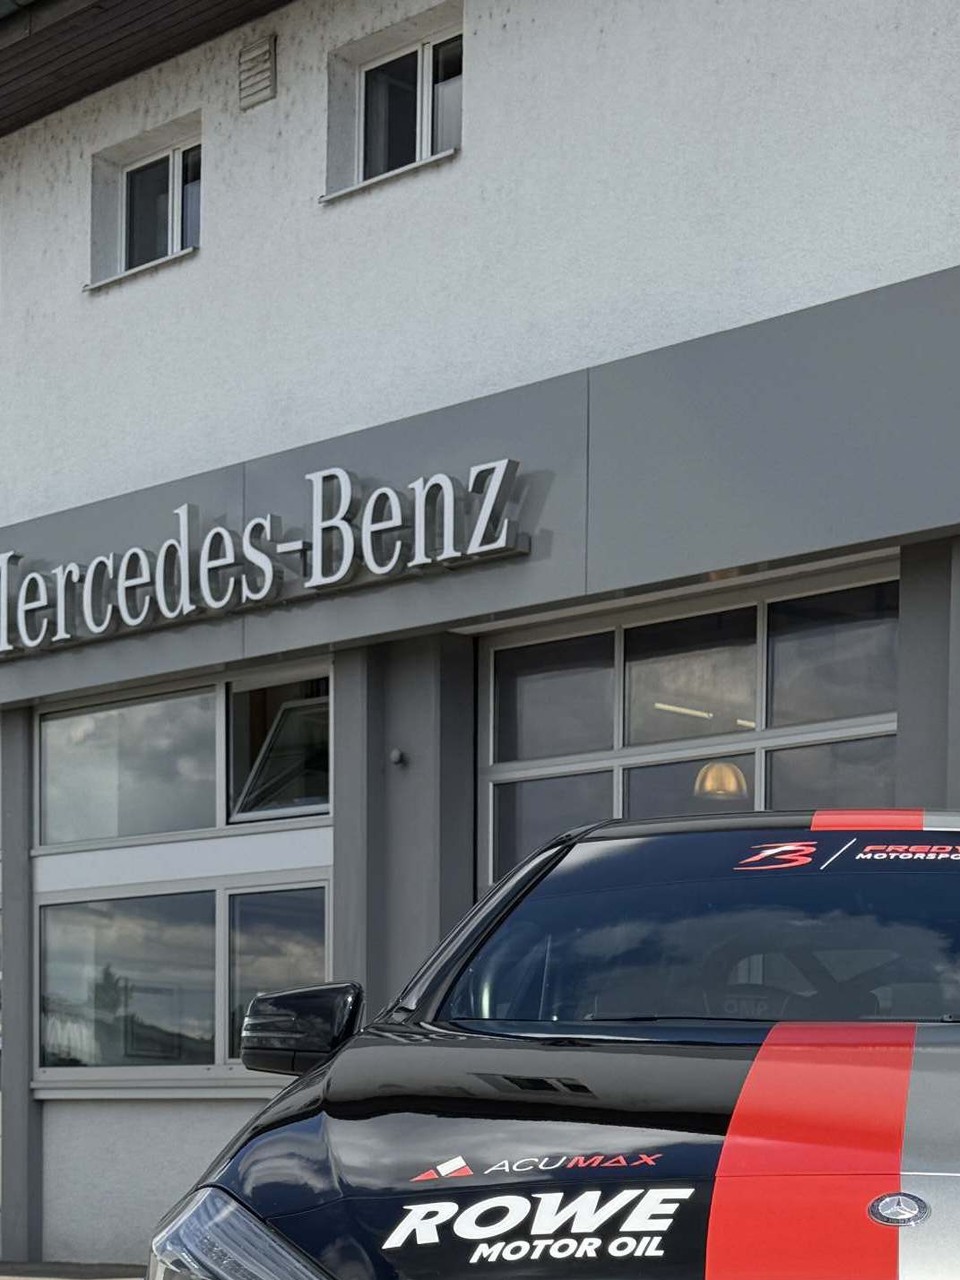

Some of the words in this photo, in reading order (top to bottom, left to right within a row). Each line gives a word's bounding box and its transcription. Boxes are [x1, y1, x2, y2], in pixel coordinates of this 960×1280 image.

[483, 1153, 663, 1174] ACUMAX
[381, 1187, 696, 1250] ROWE
[469, 1237, 602, 1264] MOTOR
[607, 1236, 664, 1256] OIL
